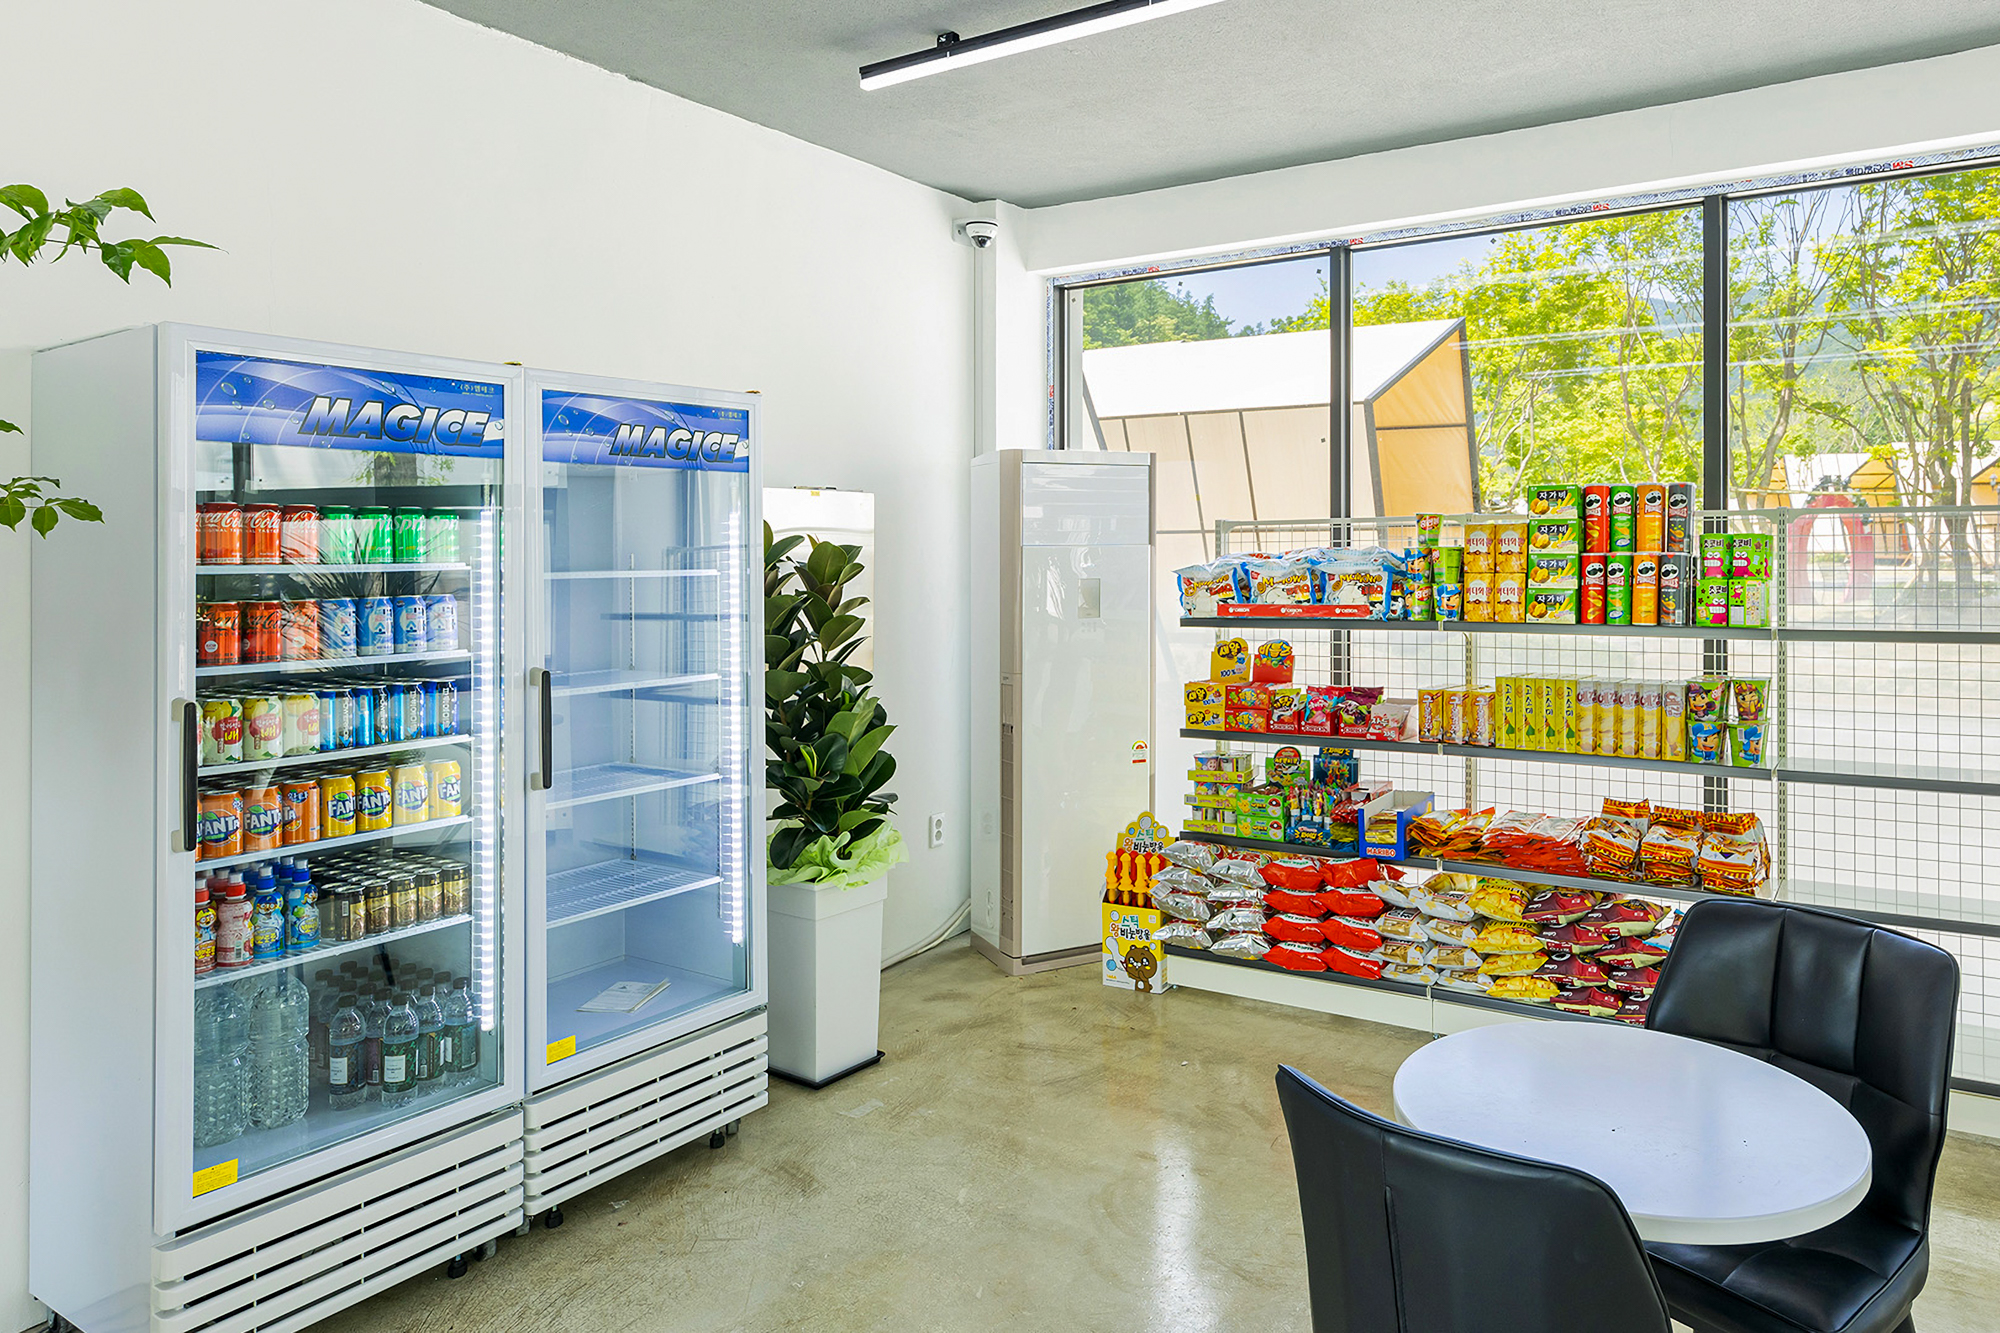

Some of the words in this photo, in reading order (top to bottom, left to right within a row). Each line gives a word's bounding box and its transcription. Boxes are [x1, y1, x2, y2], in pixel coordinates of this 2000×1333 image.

[297, 395, 492, 447] MAGICE
[608, 423, 740, 463] MAGICE
[1539, 491, 1566, 499] 자가비
[1537, 595, 1564, 603] 자가비
[1505, 684, 1513, 713] 고소미
[1525, 685, 1533, 714] 고소미
[1545, 686, 1553, 715] 고소미
[1137, 828, 1155, 841] 스틱
[1366, 847, 1396, 857] HARIBO
[1121, 915, 1139, 928] 스틱
